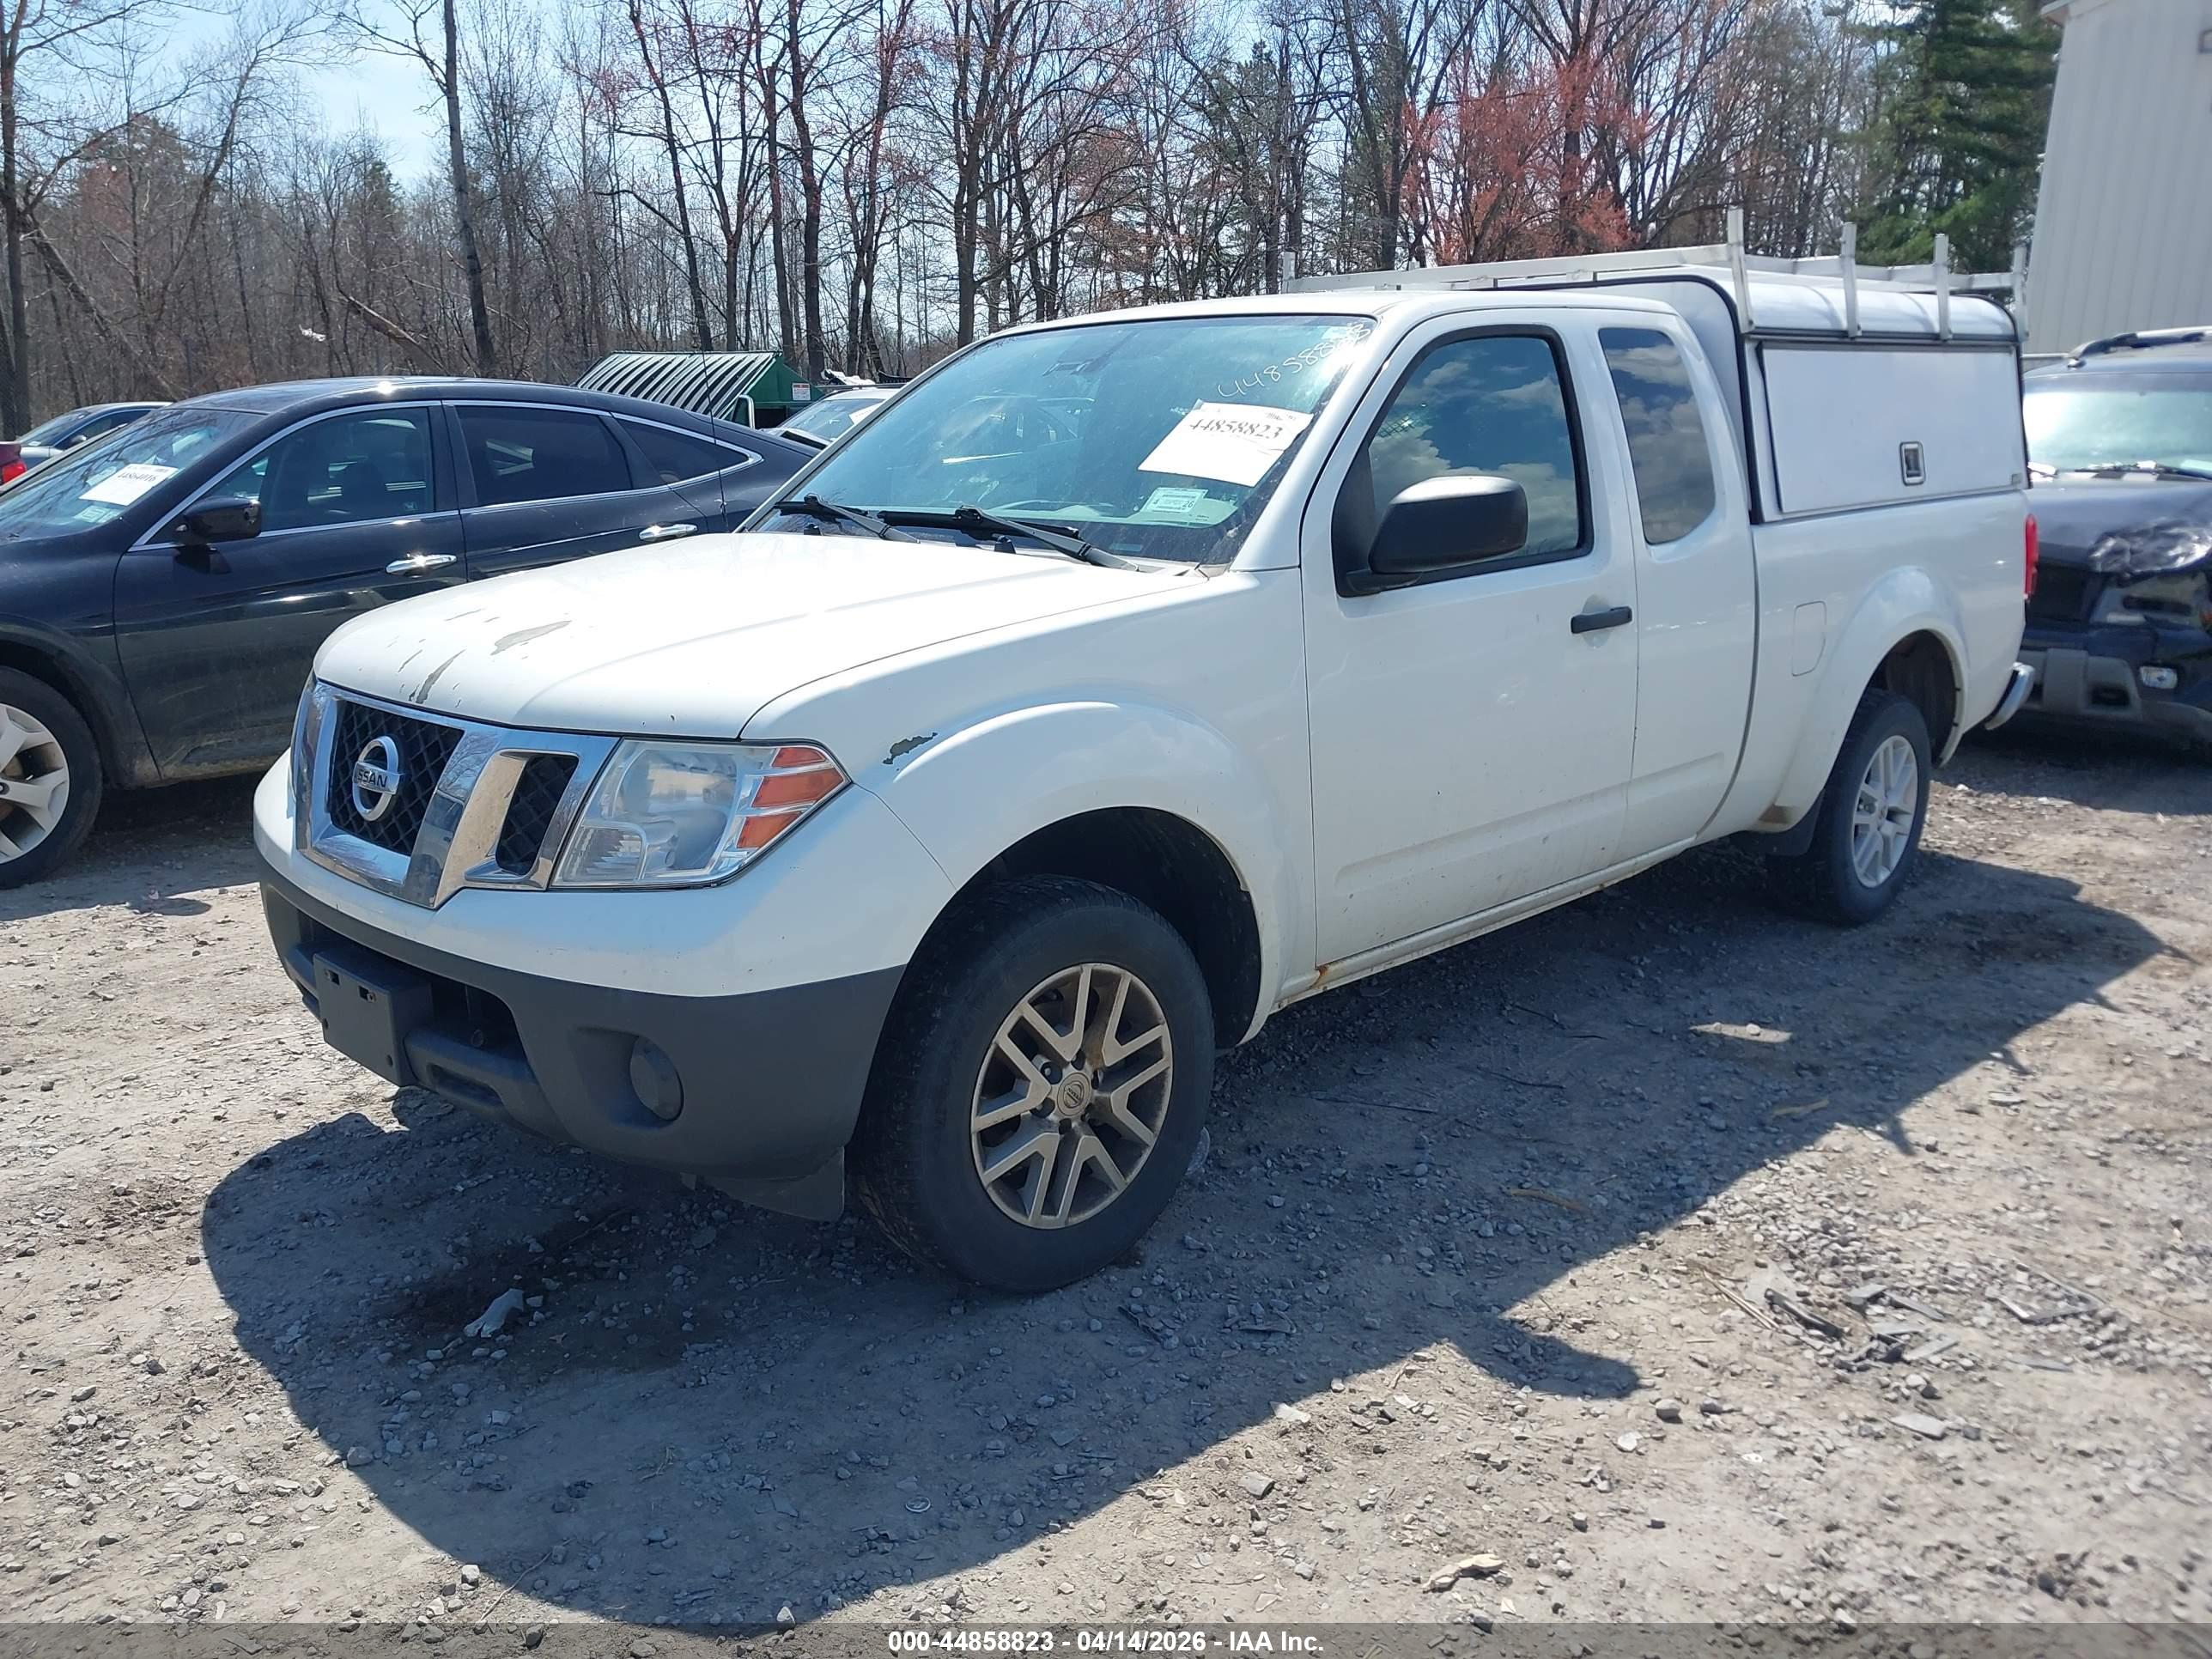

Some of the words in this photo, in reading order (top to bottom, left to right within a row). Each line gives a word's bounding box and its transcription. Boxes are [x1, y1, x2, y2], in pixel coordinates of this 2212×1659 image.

[1218, 322, 1371, 398] 4485883
[1189, 418, 1284, 440] 44858823
[354, 768, 388, 787] SSAN
